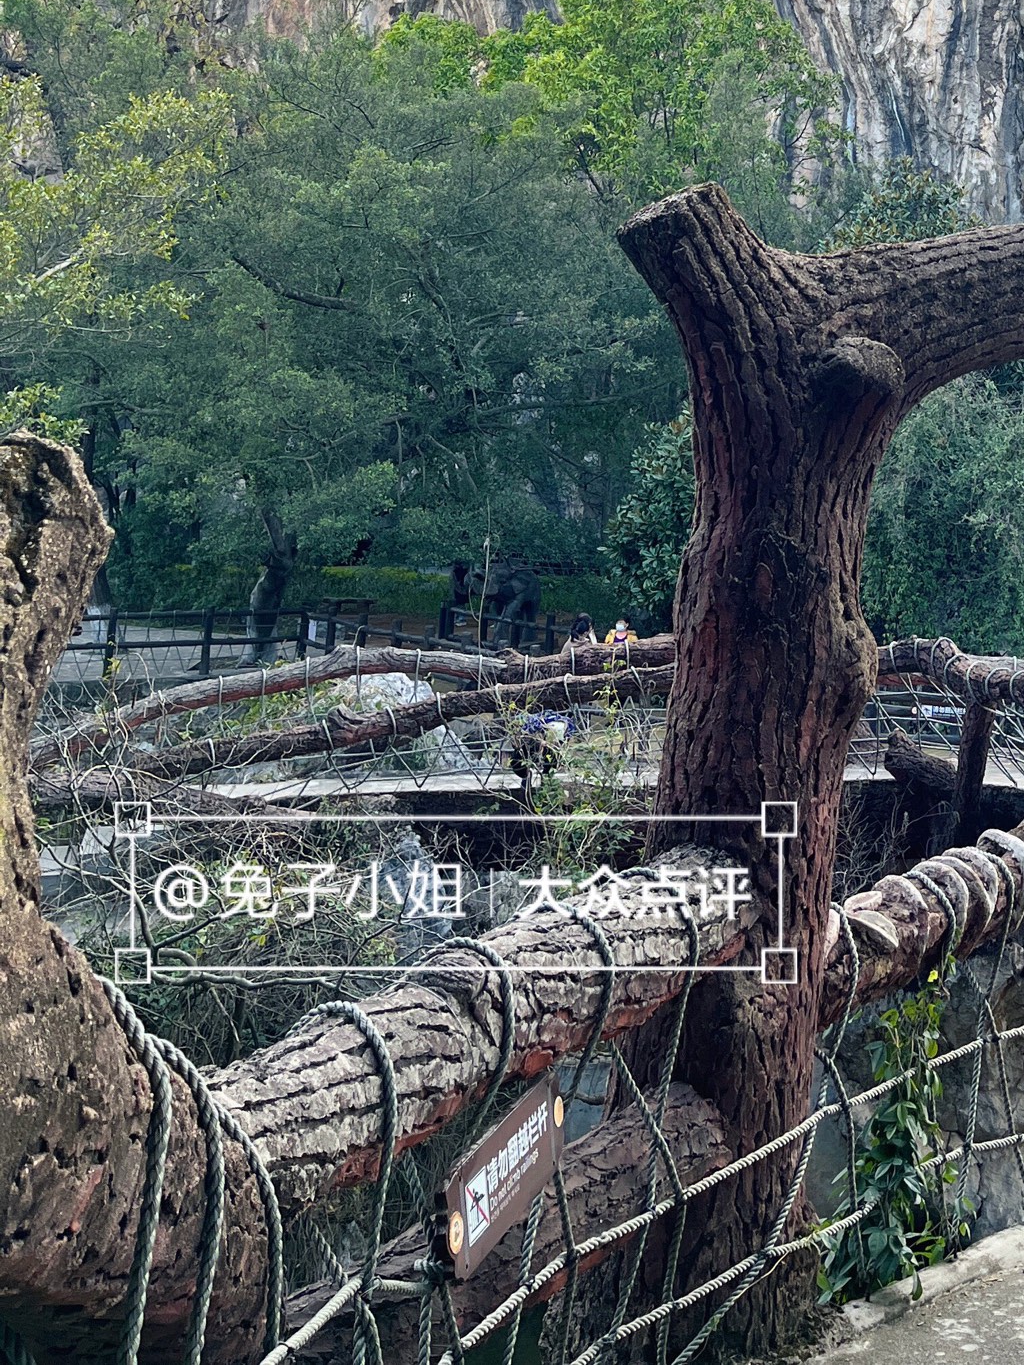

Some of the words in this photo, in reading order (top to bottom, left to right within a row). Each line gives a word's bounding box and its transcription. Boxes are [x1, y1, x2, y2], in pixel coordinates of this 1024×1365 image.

[487, 1101, 548, 1194] 请勿翻越栏杆
[490, 1196, 498, 1212] Do
[498, 1183, 507, 1202] not
[507, 1169, 521, 1191] climb
[520, 1148, 539, 1175] railings
